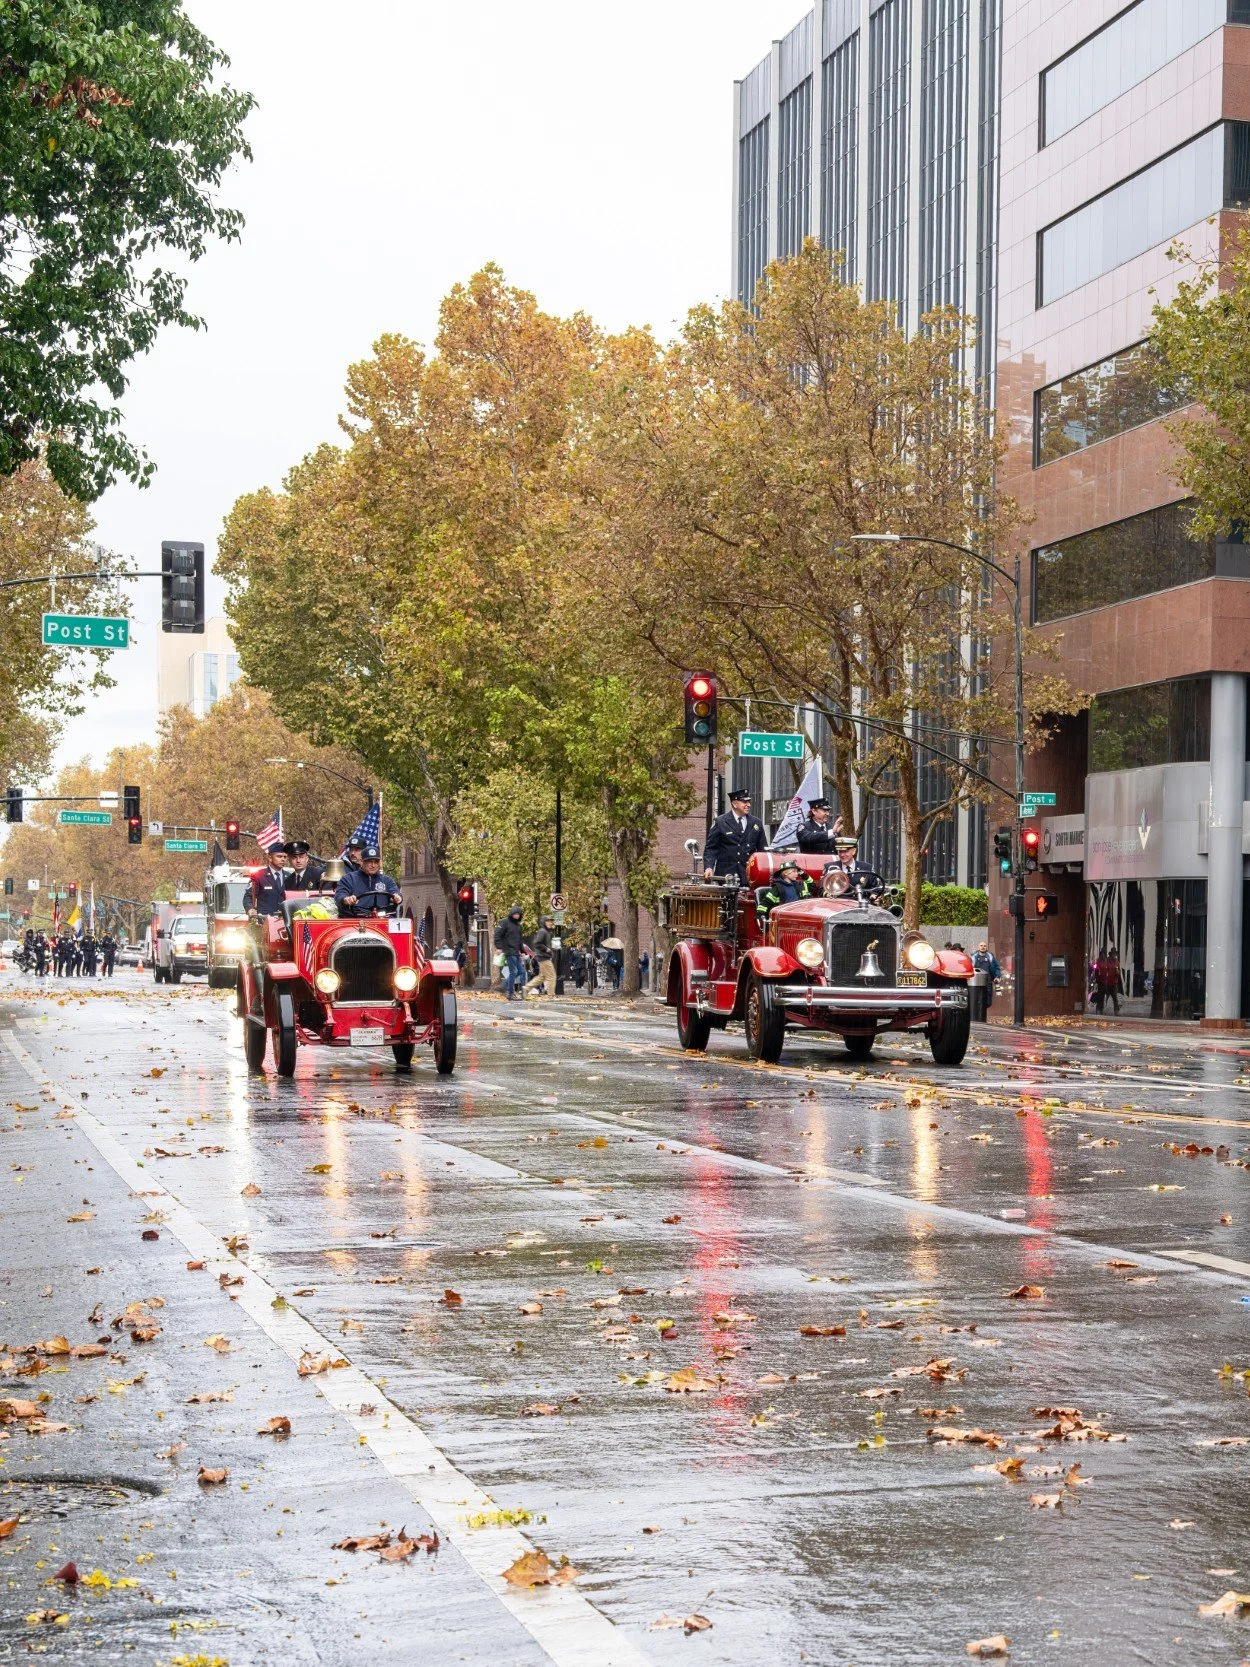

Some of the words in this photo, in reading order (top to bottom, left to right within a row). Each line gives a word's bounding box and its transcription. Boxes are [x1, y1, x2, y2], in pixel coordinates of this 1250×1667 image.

[47, 622, 92, 639] Post
[104, 625, 125, 641] St
[743, 738, 776, 751] Post
[784, 740, 800, 752] St
[1026, 795, 1045, 803] Post
[62, 814, 81, 822] Santa
[396, 922, 400, 931] 1
